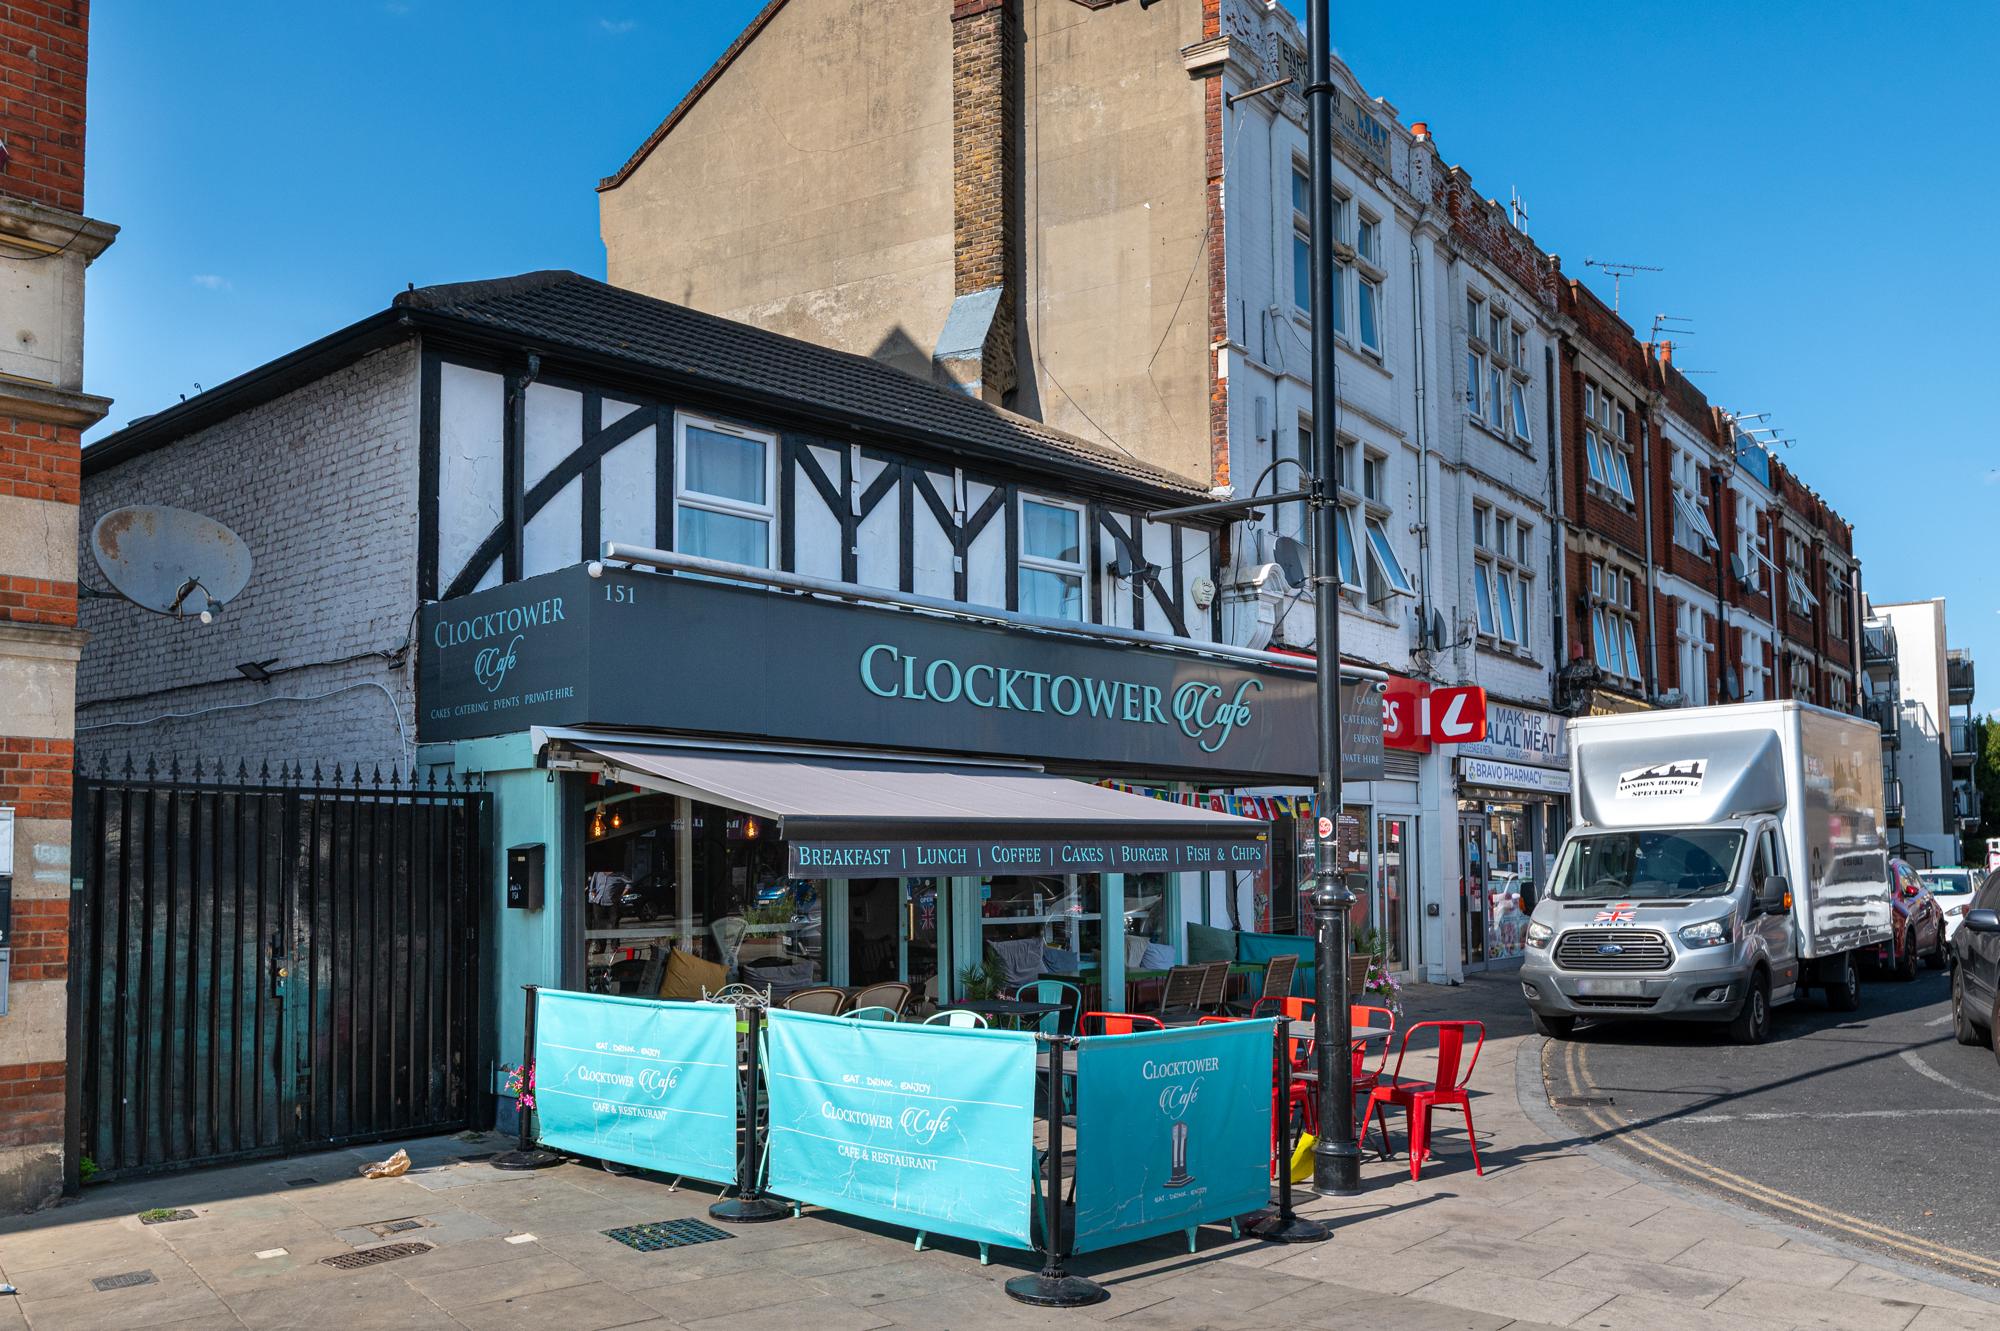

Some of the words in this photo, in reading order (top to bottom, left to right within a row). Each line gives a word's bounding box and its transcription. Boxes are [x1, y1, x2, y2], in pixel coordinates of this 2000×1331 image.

[605, 584, 634, 604] 151
[434, 597, 566, 649] CLOCKTOWER
[474, 635, 525, 693] Café
[430, 708, 450, 720] CAKES
[455, 701, 489, 716] CATERING
[493, 695, 520, 711] EVENTS
[525, 689, 554, 705] PRIVATE
[555, 686, 575, 701] HIRE
[859, 643, 1169, 725] CLOCKTOWER
[1171, 678, 1263, 754] Café
[1356, 695, 1379, 706] CAKES
[1342, 714, 1379, 727] CATERING
[1495, 707, 1542, 731] MAKHIR
[1353, 734, 1379, 745] EVENTS
[1485, 721, 1521, 748] ALAL
[1523, 729, 1556, 754] MEAT
[1342, 754, 1362, 764] IVATE
[1362, 755, 1379, 765] HIRE
[1476, 763, 1503, 780] BRAVO
[1504, 765, 1543, 785] PHARMACY
[1619, 781, 1655, 791] LONDON
[1658, 780, 1699, 788] REMOVAL
[1632, 788, 1685, 797] SPECIALIST
[799, 846, 891, 866] BREAKFAST
[917, 846, 967, 865] LUNCH
[991, 845, 1041, 863] COFFEE
[1062, 846, 1104, 862] CAKES
[1122, 846, 1169, 862] BURGER
[1186, 845, 1211, 861] FISH
[1217, 847, 1226, 861] &
[1231, 845, 1262, 861] CHIPS
[595, 1042, 609, 1050] EAT
[613, 1044, 636, 1053] DRINK
[640, 1047, 661, 1058] ENJOY
[1142, 1057, 1219, 1080] CLOCKTOWER
[578, 1065, 635, 1088] CLOCKTOWER
[639, 1066, 683, 1100] Café
[842, 1074, 860, 1083] EAT
[867, 1077, 893, 1088] DRINK
[900, 1081, 931, 1094] ENJOY
[1159, 1075, 1205, 1120] Café
[611, 1105, 617, 1114] &
[618, 1106, 668, 1120] RESTAURANT
[821, 1100, 893, 1130] CLOCKTOWER
[900, 1105, 958, 1145] Café
[838, 1145, 860, 1159] CAFE
[862, 1149, 870, 1161] &
[871, 1151, 938, 1171] RESTAURANT
[1154, 1195, 1165, 1203] EAT
